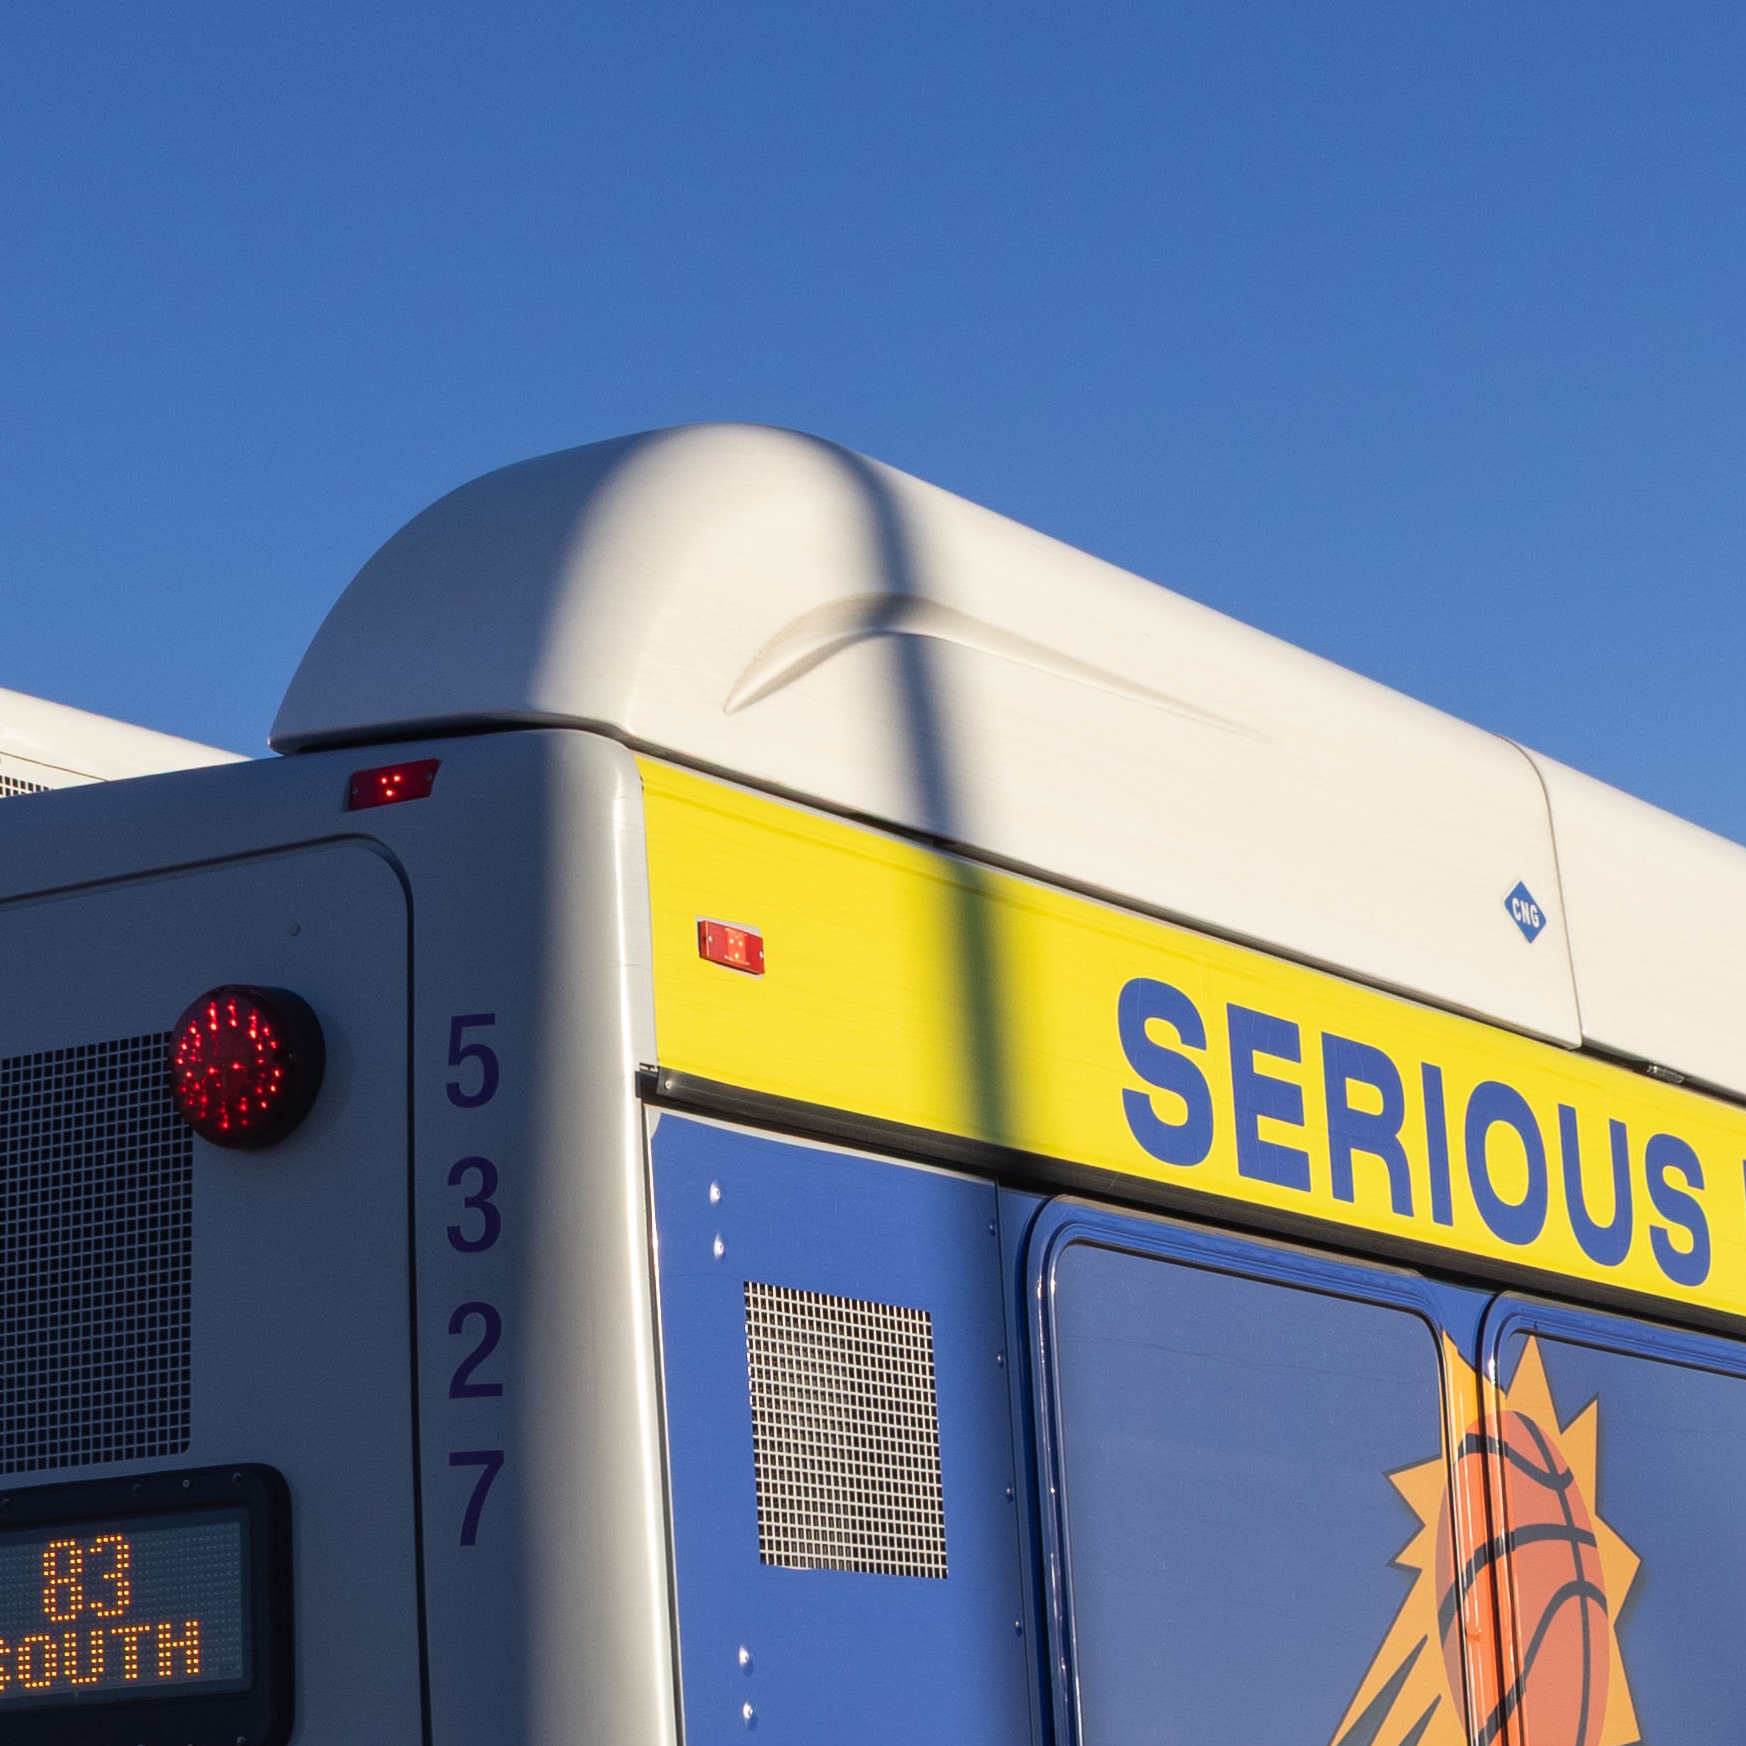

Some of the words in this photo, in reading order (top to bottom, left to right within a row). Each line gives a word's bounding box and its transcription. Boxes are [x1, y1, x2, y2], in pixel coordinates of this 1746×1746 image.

[1512, 897, 1540, 928] CNG
[1116, 977, 1712, 1287] SERIOUS
[41, 1532, 133, 1623] 83
